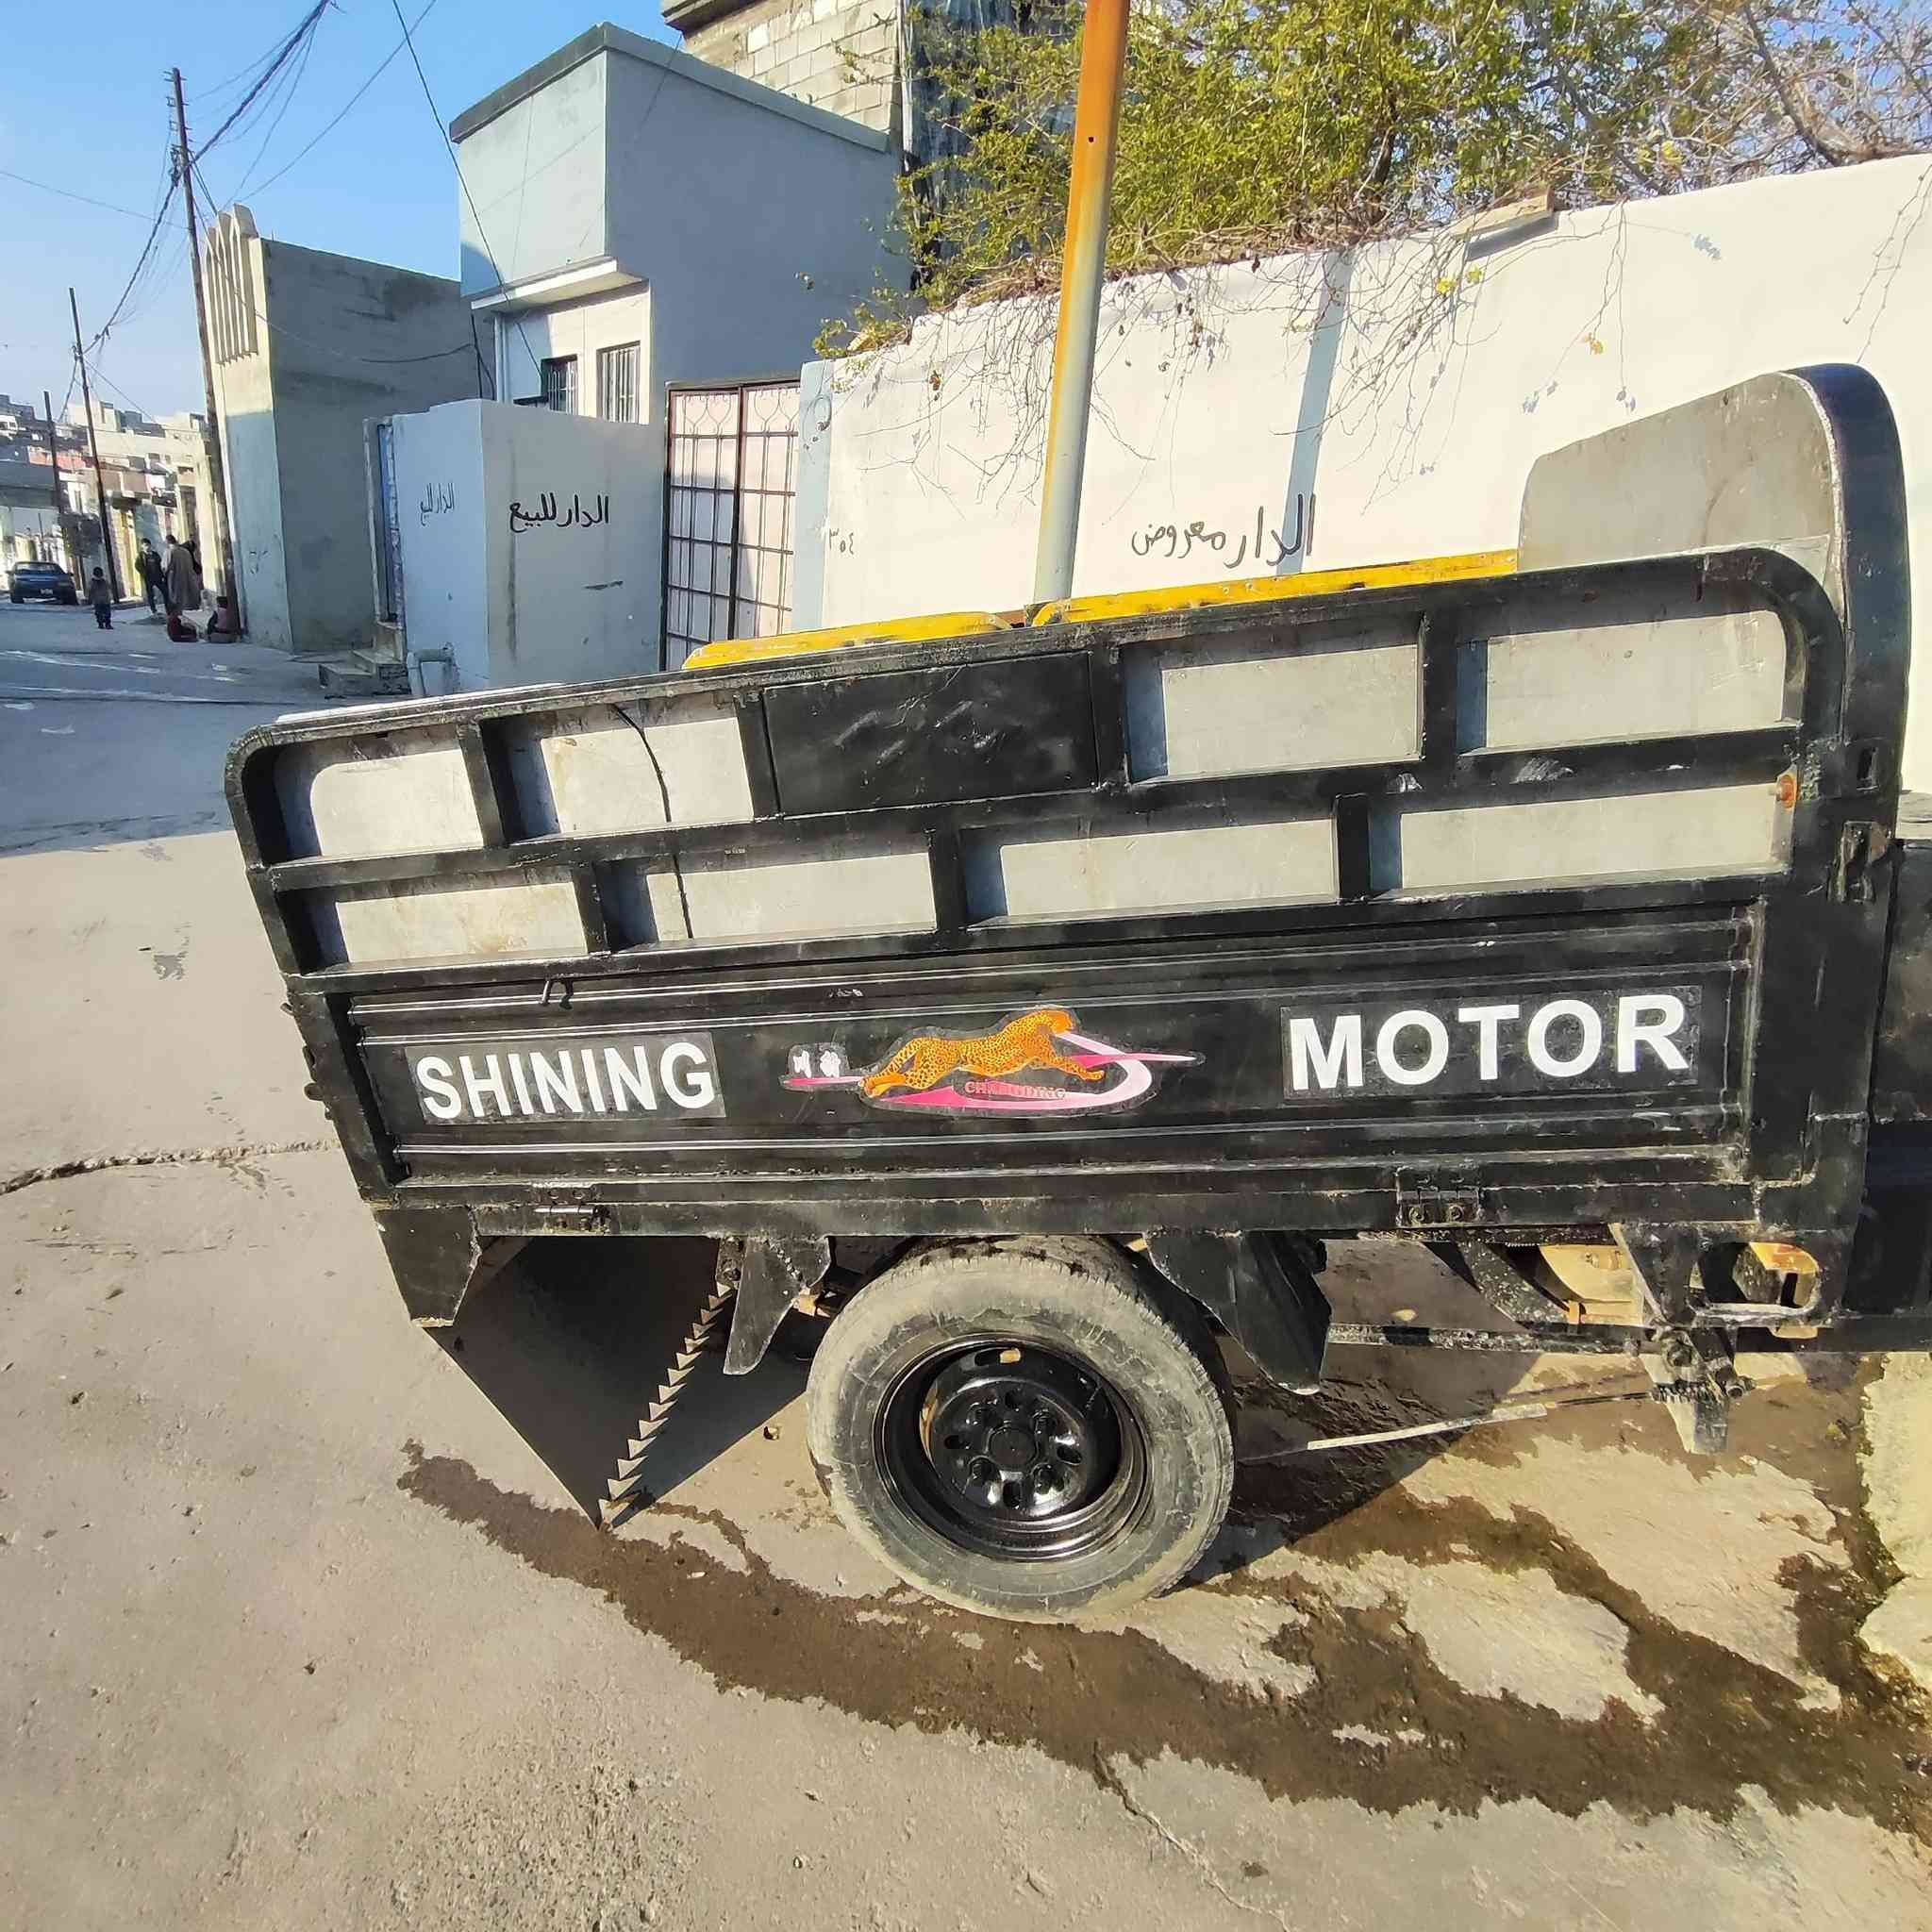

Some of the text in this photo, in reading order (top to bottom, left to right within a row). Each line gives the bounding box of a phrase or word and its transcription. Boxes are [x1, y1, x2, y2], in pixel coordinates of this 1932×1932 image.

[509, 491, 609, 533] الدار للبيع
[1131, 493, 1316, 569] الدار معروض
[416, 994, 1690, 1120] SHINING MOTOR
